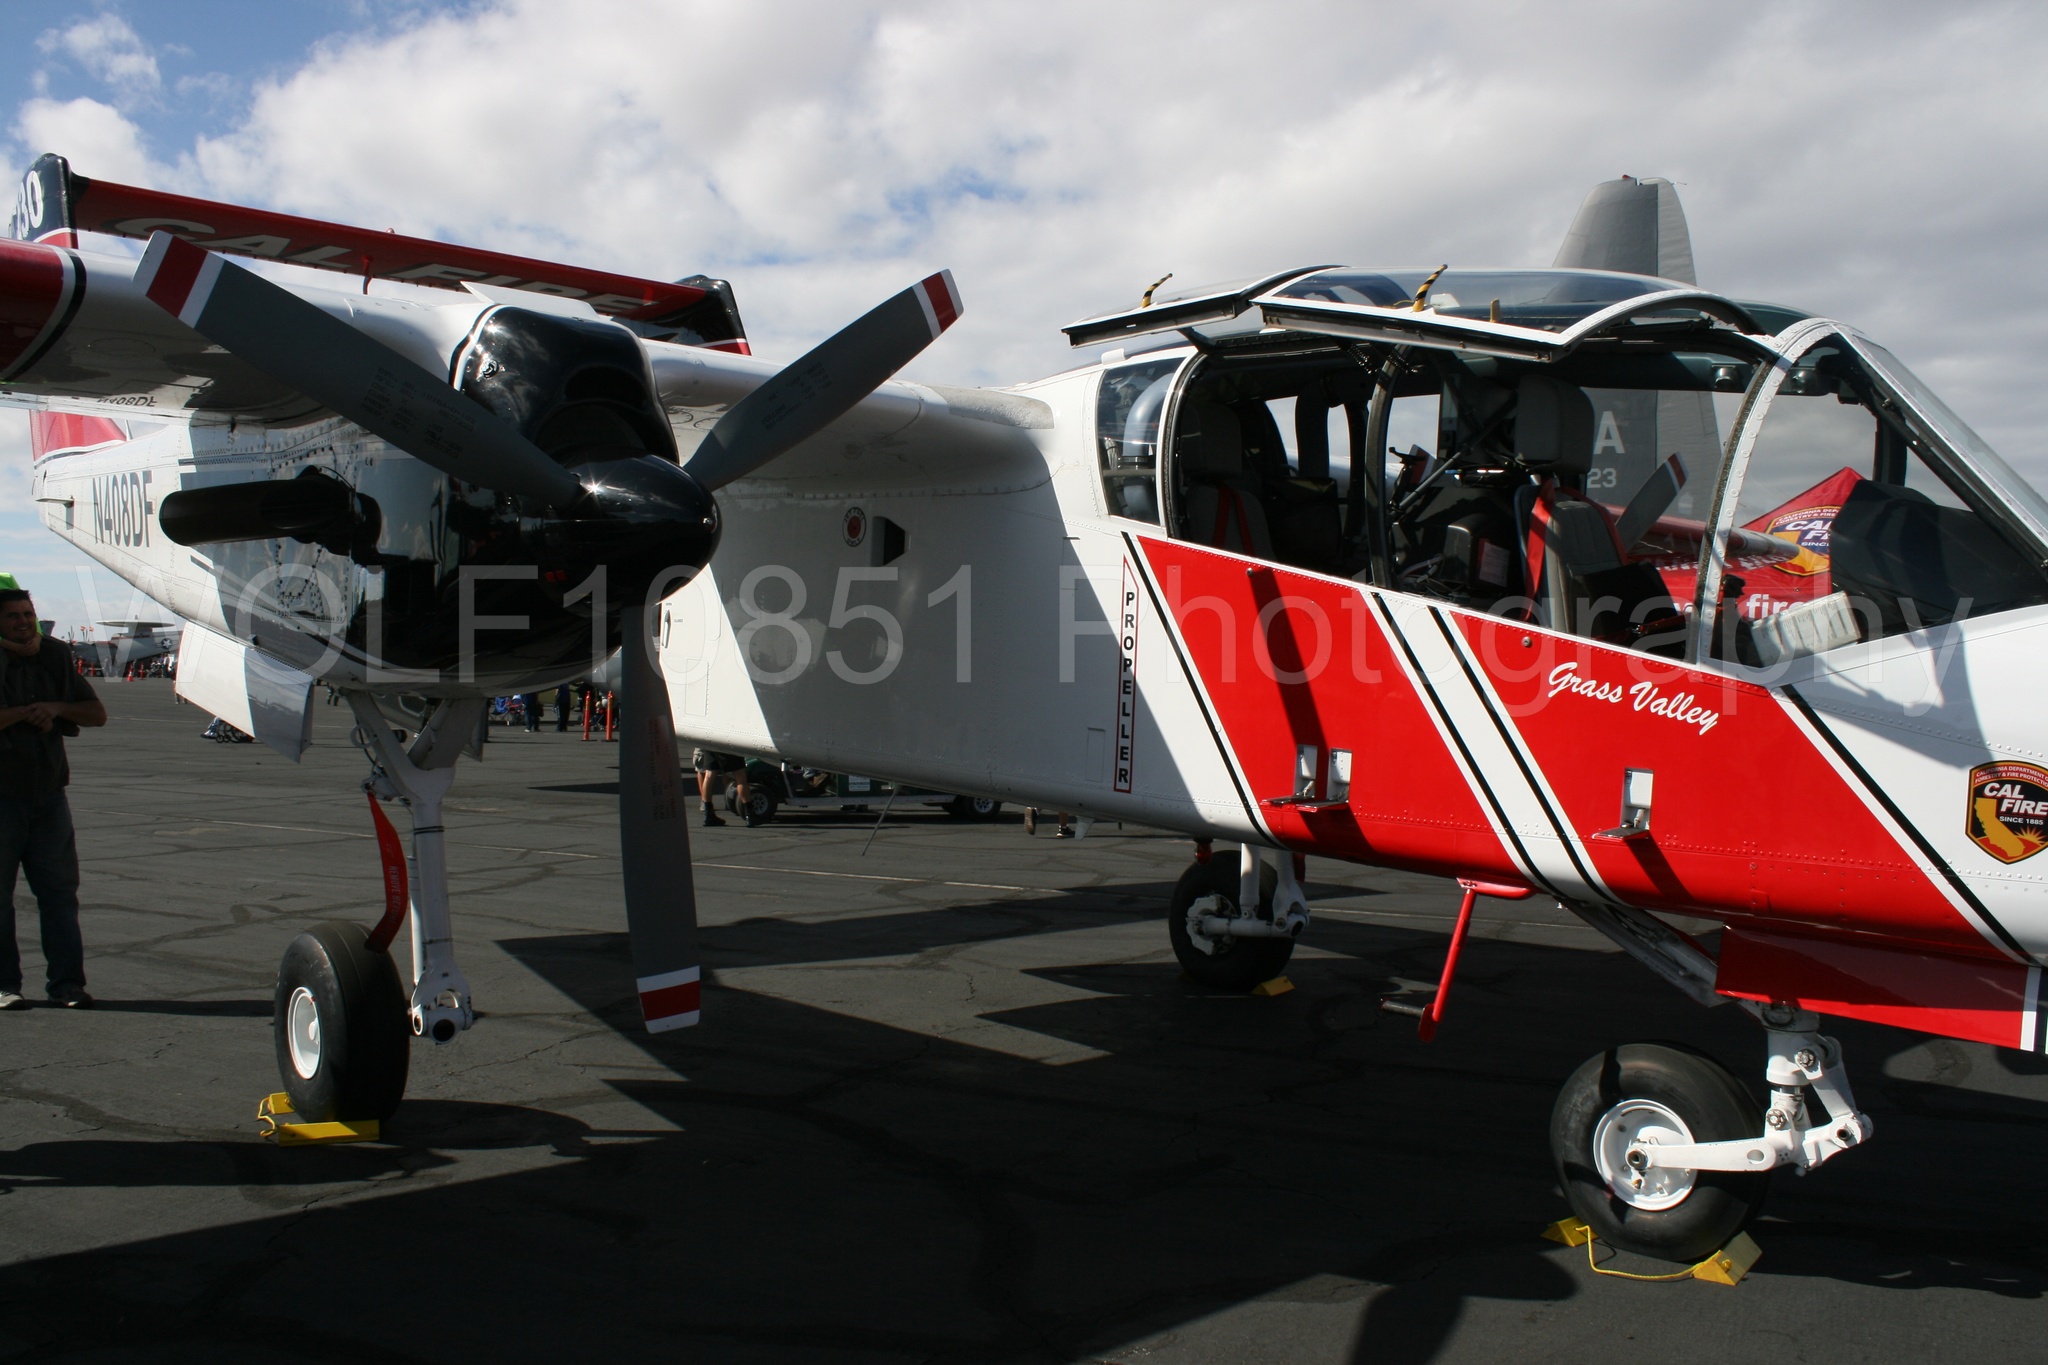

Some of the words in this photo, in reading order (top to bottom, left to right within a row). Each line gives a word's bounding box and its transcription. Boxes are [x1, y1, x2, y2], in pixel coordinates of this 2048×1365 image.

[114, 217, 352, 268] CAL
[92, 470, 153, 548] N408DF
[1118, 591, 1136, 784] PROPELLER
[1547, 661, 1623, 704] Grass
[1629, 681, 1720, 736] Valley
[1974, 773, 2001, 784] FORESTRY
[1976, 766, 2007, 777] CALIFORNIA
[2008, 766, 2044, 779] DEPARTMENT
[1983, 782, 2024, 799] CAL
[2000, 799, 2048, 815] FIRE
[1999, 815, 2024, 824] SINCE
[2025, 818, 2044, 826] 1885
